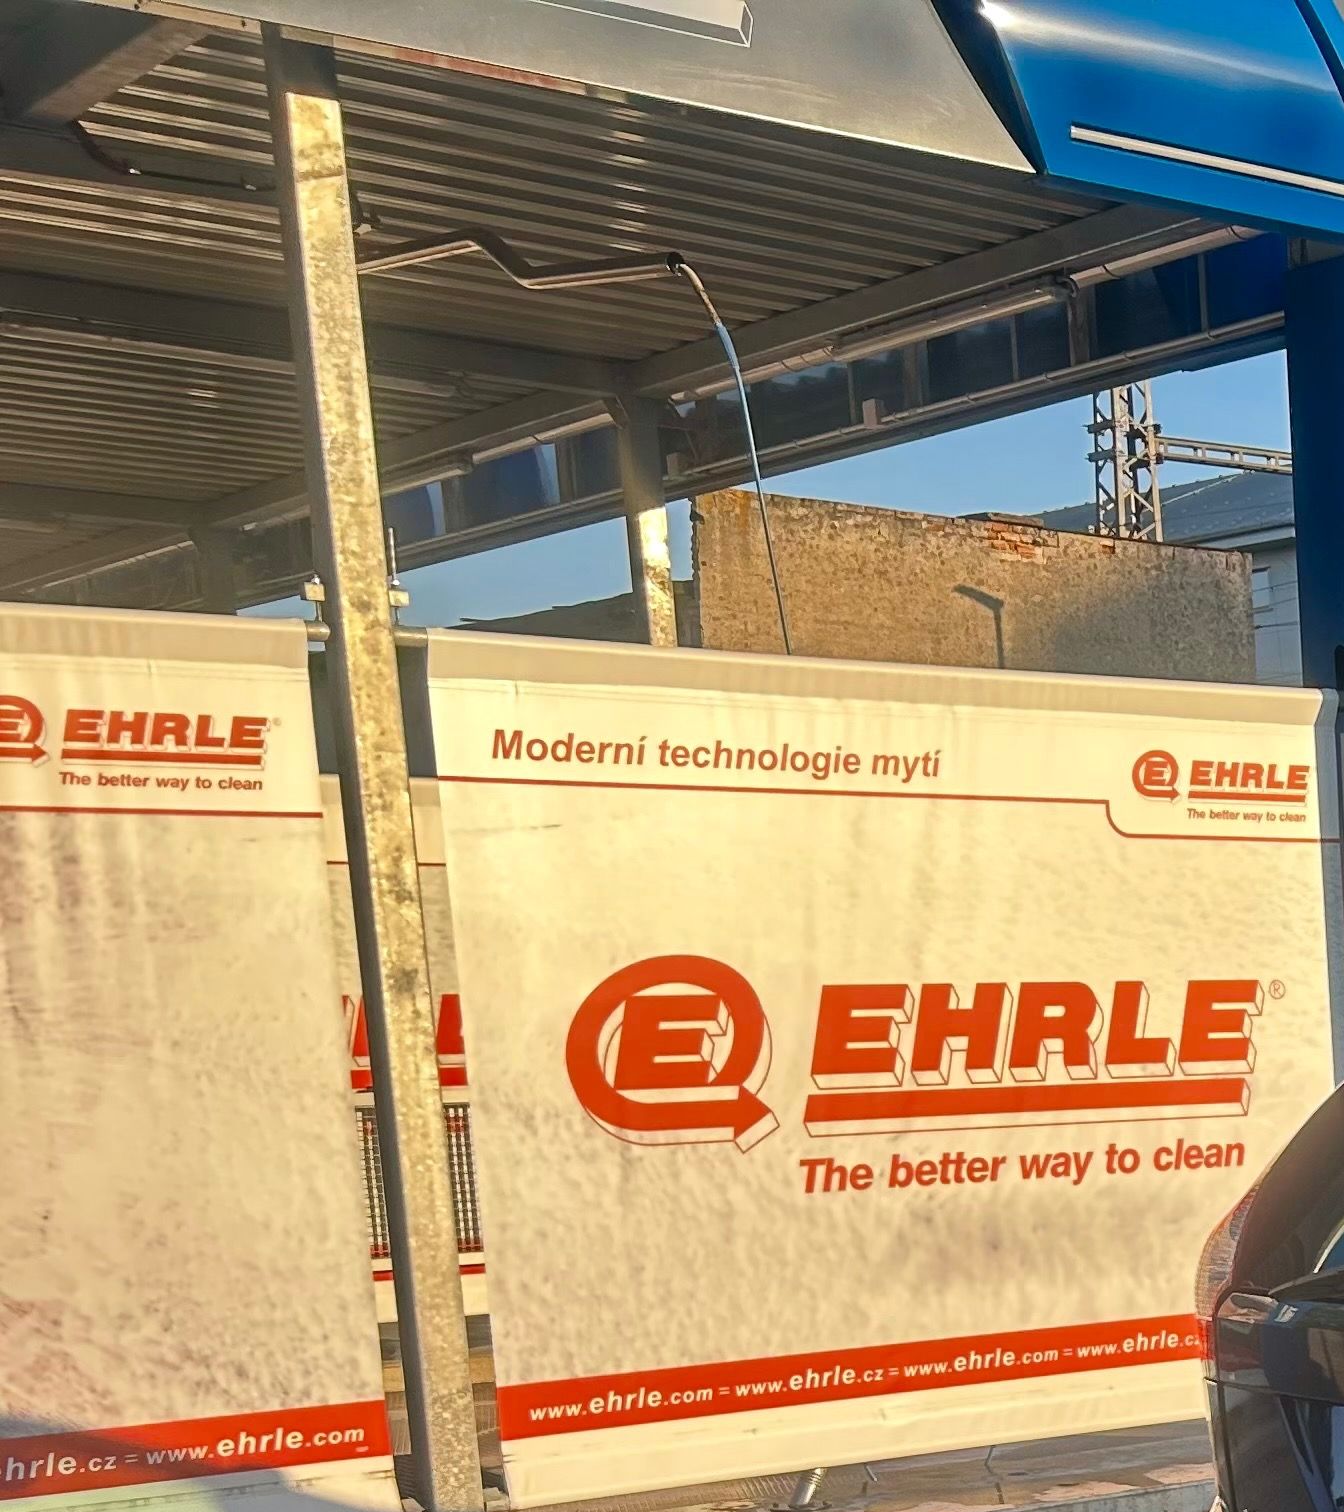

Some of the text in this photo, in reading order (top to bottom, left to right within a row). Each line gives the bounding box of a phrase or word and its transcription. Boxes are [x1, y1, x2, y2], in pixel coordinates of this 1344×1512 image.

[63, 708, 270, 752] EHRLE
[491, 728, 944, 784] Moderní technologie mytí
[59, 771, 263, 792] The better way to clean
[1189, 760, 1311, 790] EHRLE
[1187, 807, 1306, 824] The better way to clean
[811, 979, 1265, 1090] EHRLE
[799, 1137, 1246, 1194] The better way to clean
[529, 1386, 714, 1421] www.ehrle.com
[735, 1364, 884, 1398] www.ehrle.cz
[903, 1347, 1059, 1378] www.ehrle.com
[0, 1451, 117, 1482] hrle.cz
[146, 1425, 366, 1466] www.ehrle.com
